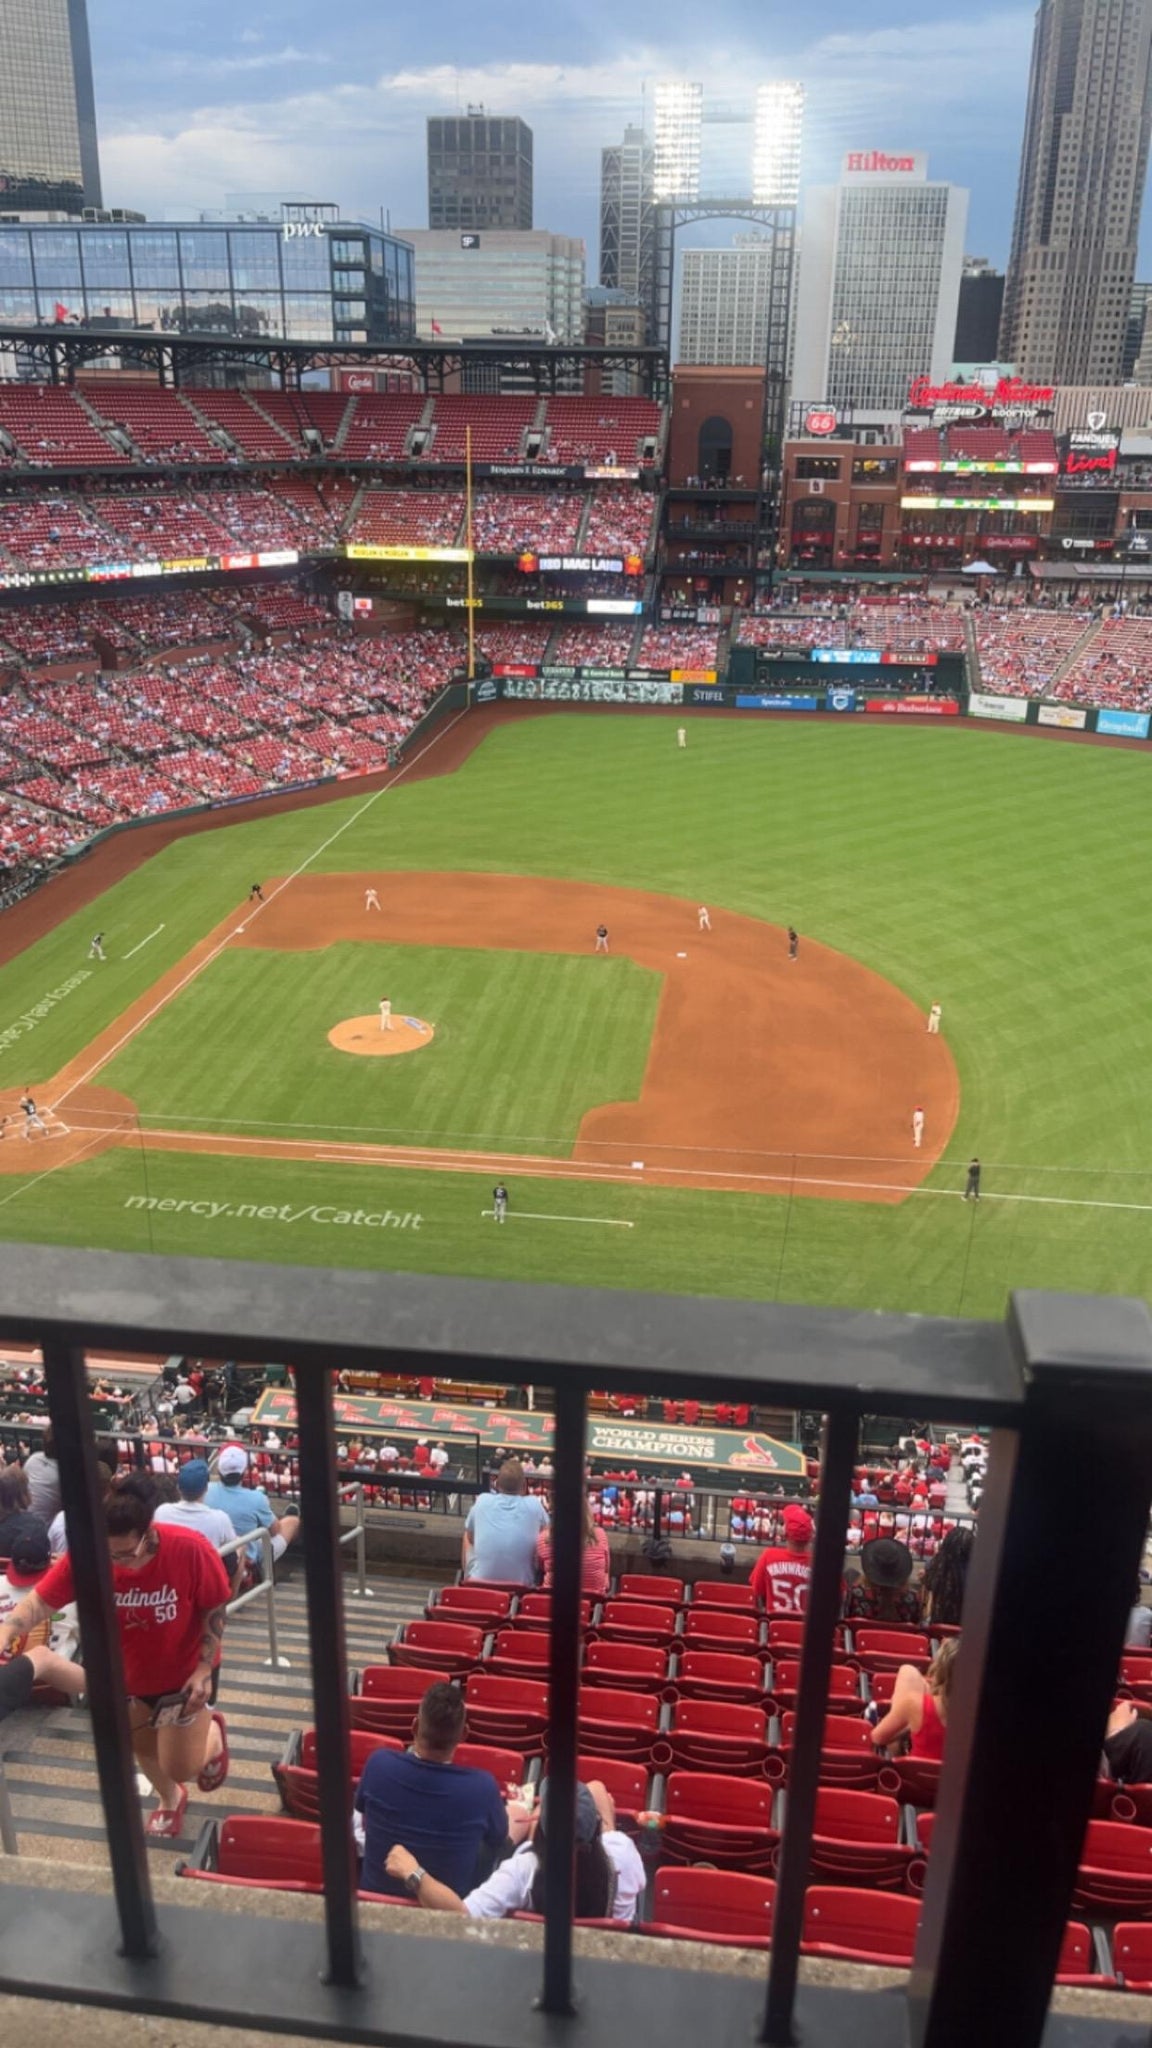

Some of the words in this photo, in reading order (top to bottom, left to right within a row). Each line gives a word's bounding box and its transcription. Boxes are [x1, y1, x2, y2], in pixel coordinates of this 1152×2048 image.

[848, 150, 914, 171] Hilton
[282, 222, 325, 242] pwc
[911, 375, 985, 406] Cardinals
[984, 376, 1054, 407] Nation
[811, 416, 831, 429] 66
[992, 409, 1038, 417] ROOFTOP
[1070, 433, 1118, 445] FANDUEL
[1066, 449, 1117, 473] Live!
[562, 558, 591, 570] MAC
[526, 600, 564, 609] bet365
[693, 689, 724, 701] STIFEL
[897, 703, 943, 713] Budweiser
[124, 1195, 425, 1230] mercy.net/CatchIt
[593, 1426, 656, 1440] WORLD
[659, 1432, 715, 1446] SERIES
[592, 1436, 715, 1459] CHAMPIONS
[114, 1584, 178, 1607] rdinals
[155, 1604, 177, 1624] 50
